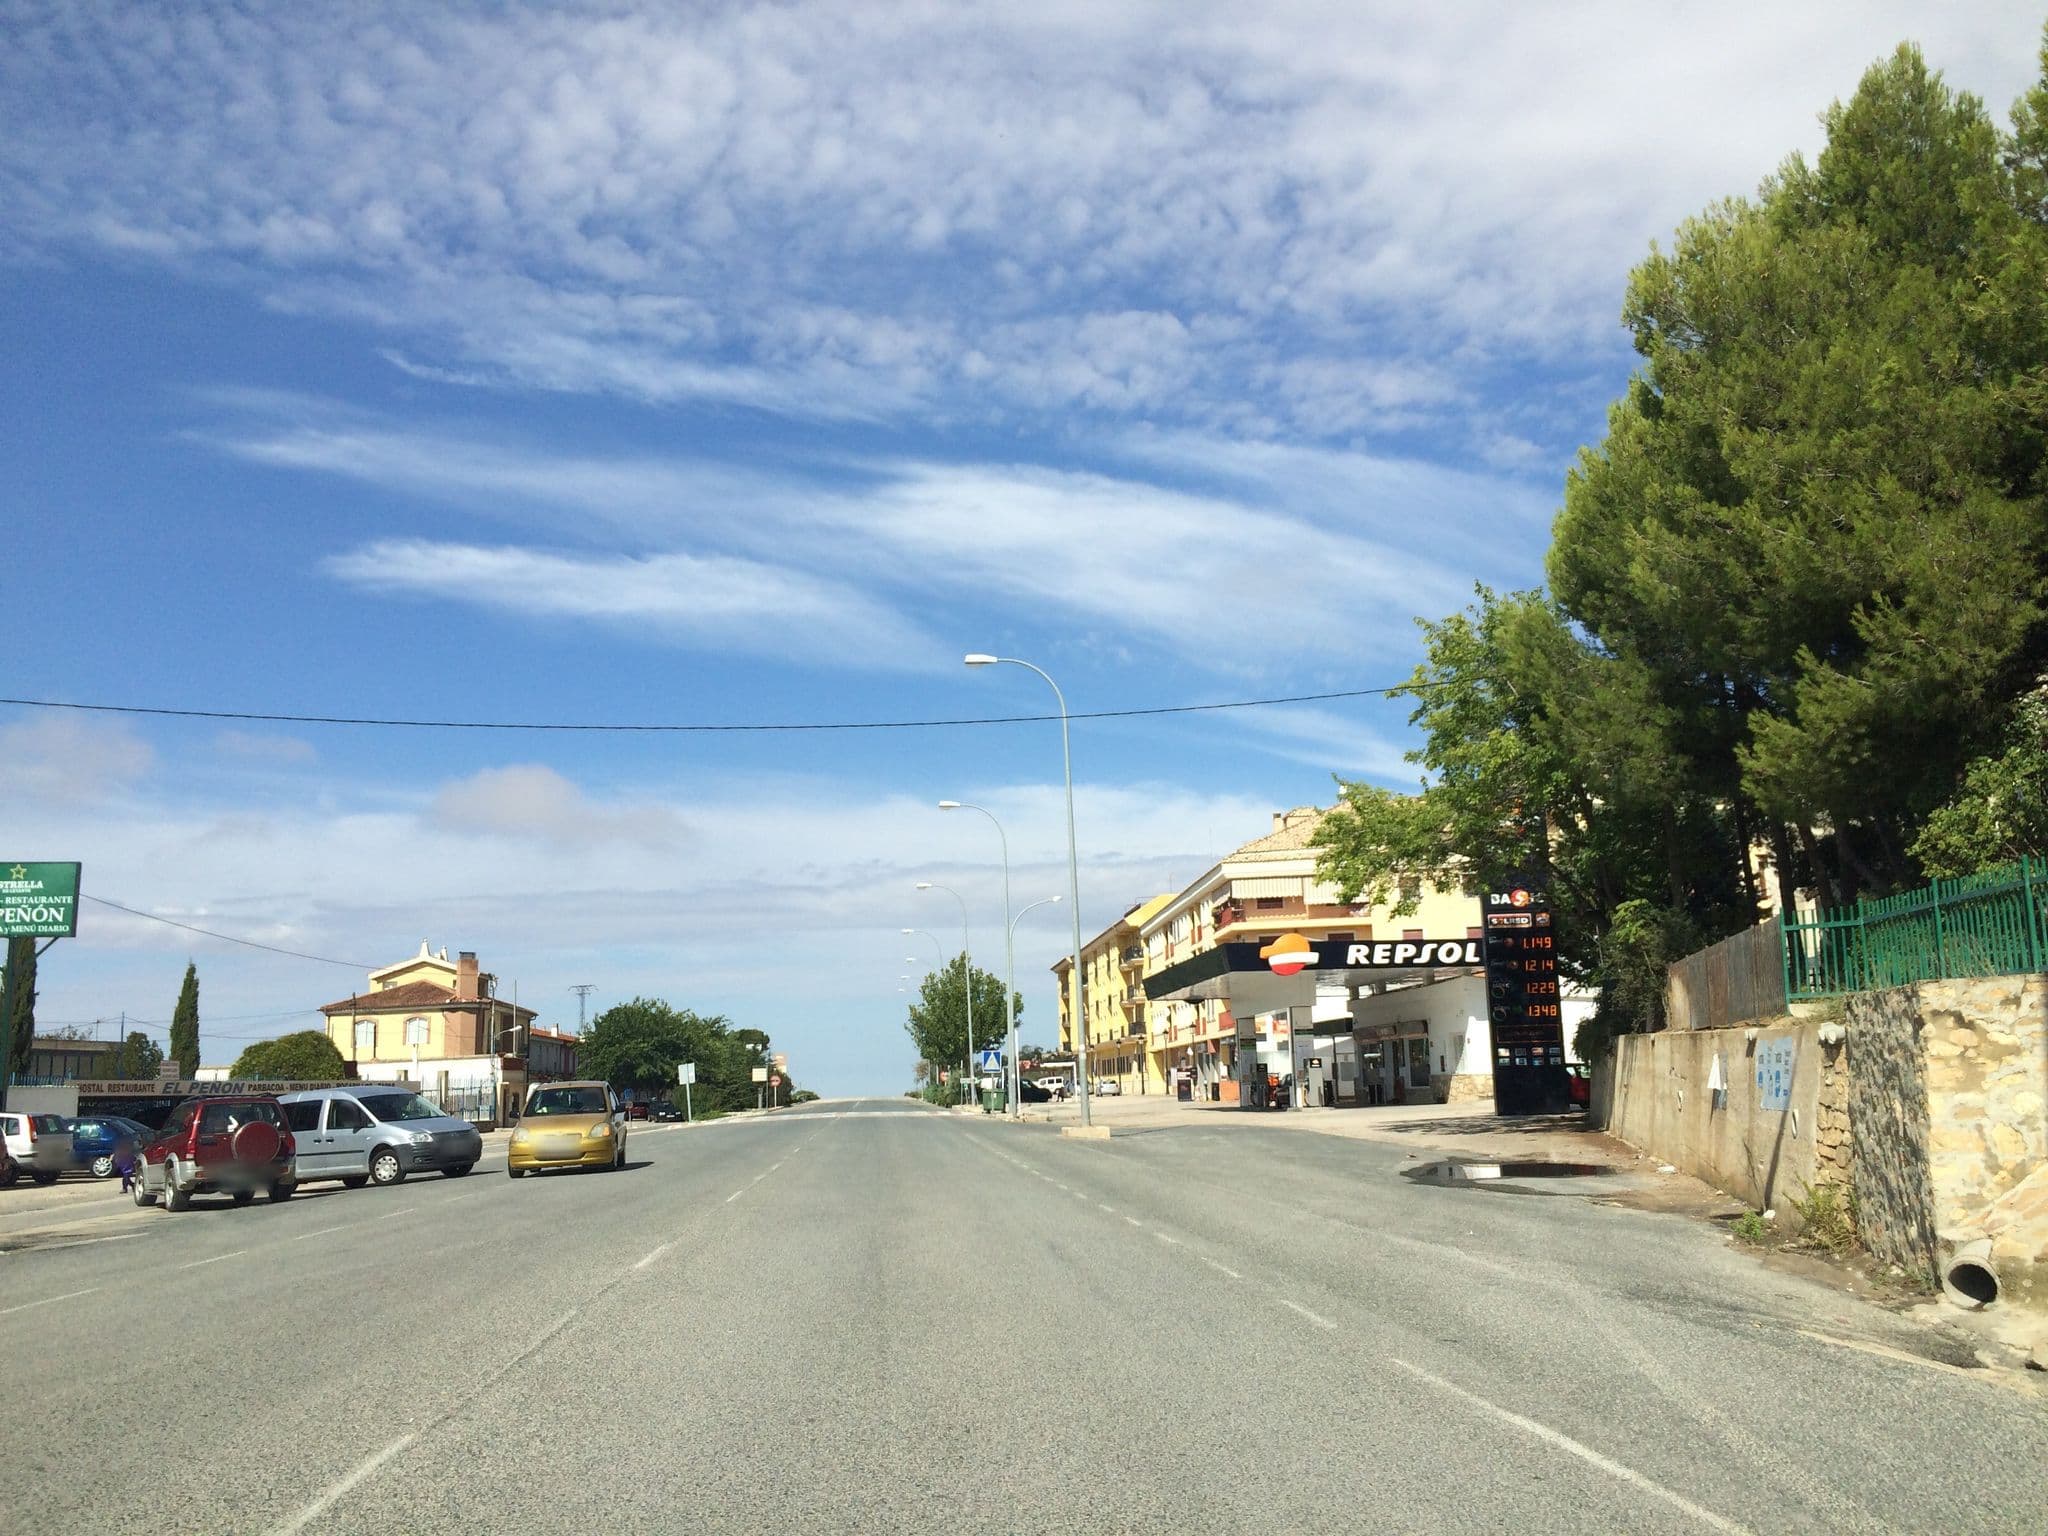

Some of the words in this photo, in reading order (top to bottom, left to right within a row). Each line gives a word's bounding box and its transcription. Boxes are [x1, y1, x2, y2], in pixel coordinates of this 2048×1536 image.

[5, 896, 73, 904] RESTAURANTE
[38, 924, 69, 932] DIARIO
[1346, 942, 1480, 965] REPSOL
[107, 1084, 155, 1093] RESTAURANTE
[162, 1082, 182, 1094] EL
